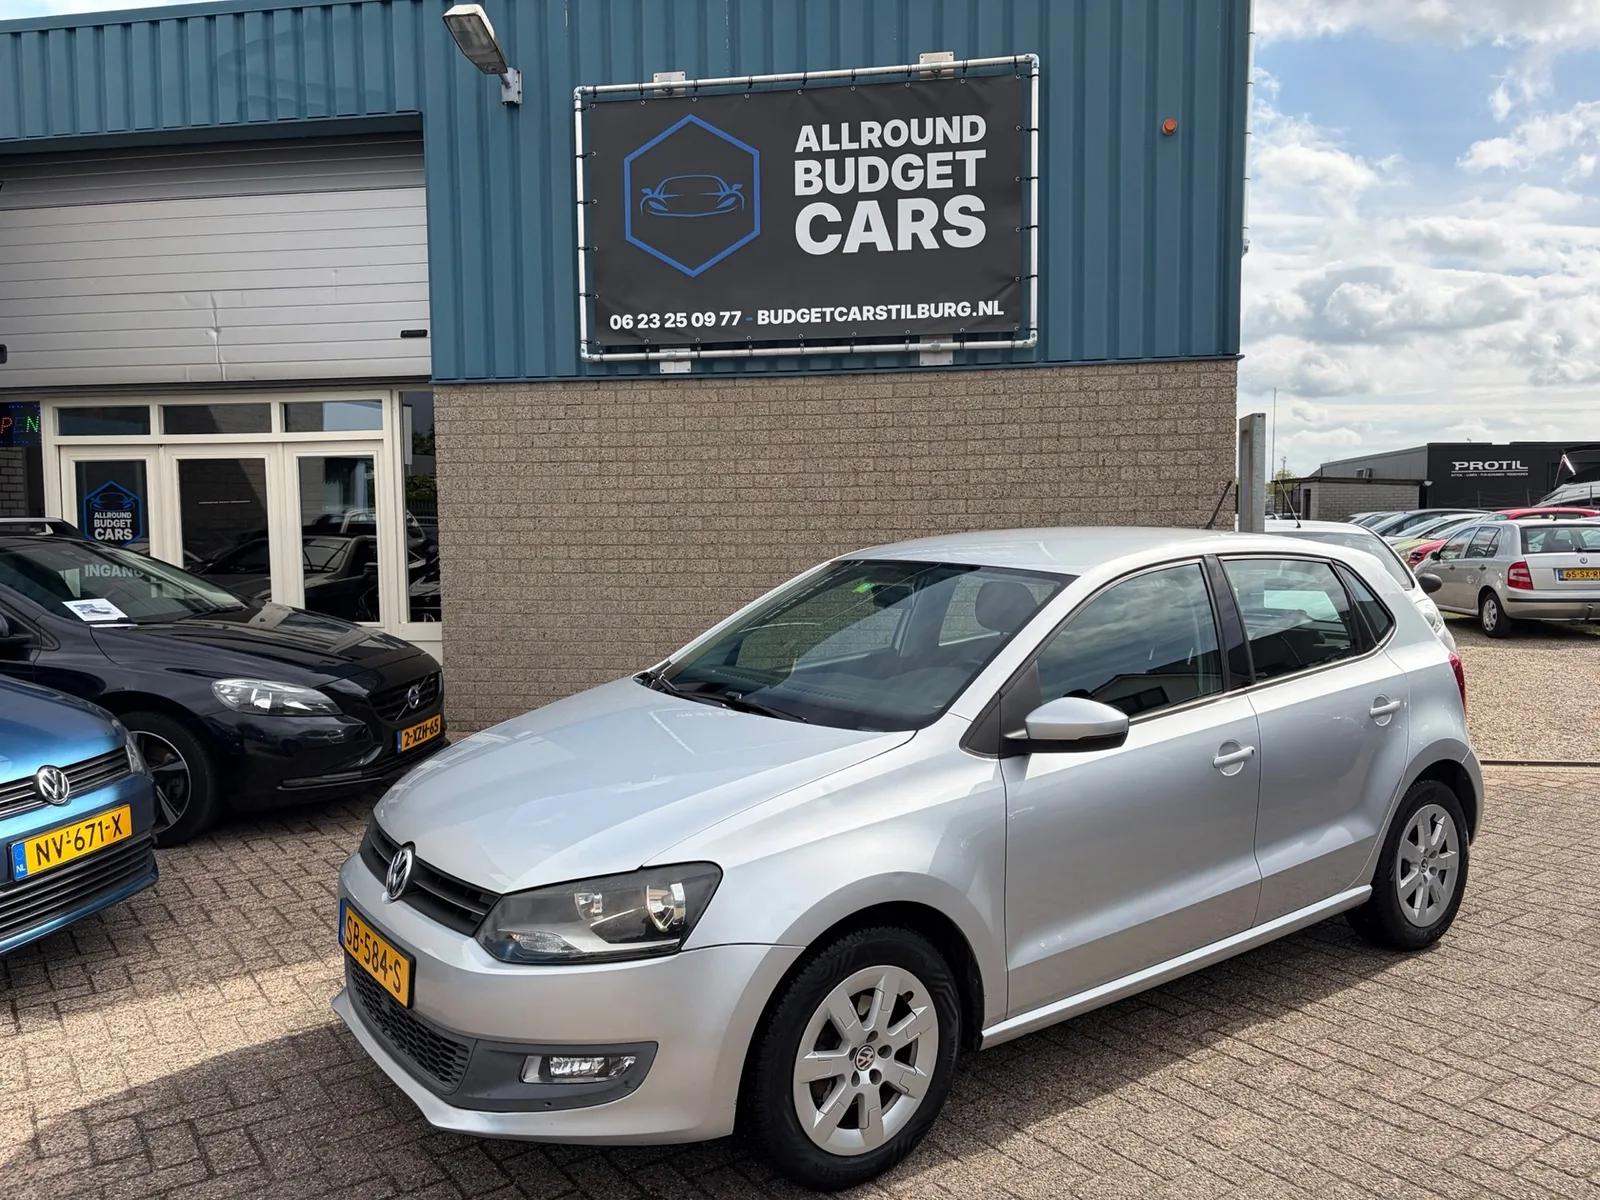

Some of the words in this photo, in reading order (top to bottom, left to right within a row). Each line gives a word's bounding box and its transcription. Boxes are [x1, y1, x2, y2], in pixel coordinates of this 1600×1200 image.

[795, 114, 986, 152] ALLROUND
[794, 149, 986, 196] BUDGET
[795, 195, 986, 255] CARS
[609, 314, 633, 330] 06
[637, 313, 661, 329] 23
[664, 312, 687, 328] 25
[690, 311, 716, 327] 09
[719, 311, 742, 326] 77
[757, 300, 1004, 325] BUDGETCARSTILBURG.NL
[1452, 460, 1528, 470] PROTIL
[94, 519, 132, 528] BUDGET
[94, 528, 133, 540] CARS
[1566, 570, 1600, 578] 65-SX-R
[404, 717, 439, 747] 2-XZH-65
[35, 813, 122, 866] NV-671-X
[16, 864, 26, 873] NL
[346, 915, 402, 994] SB-584-S
